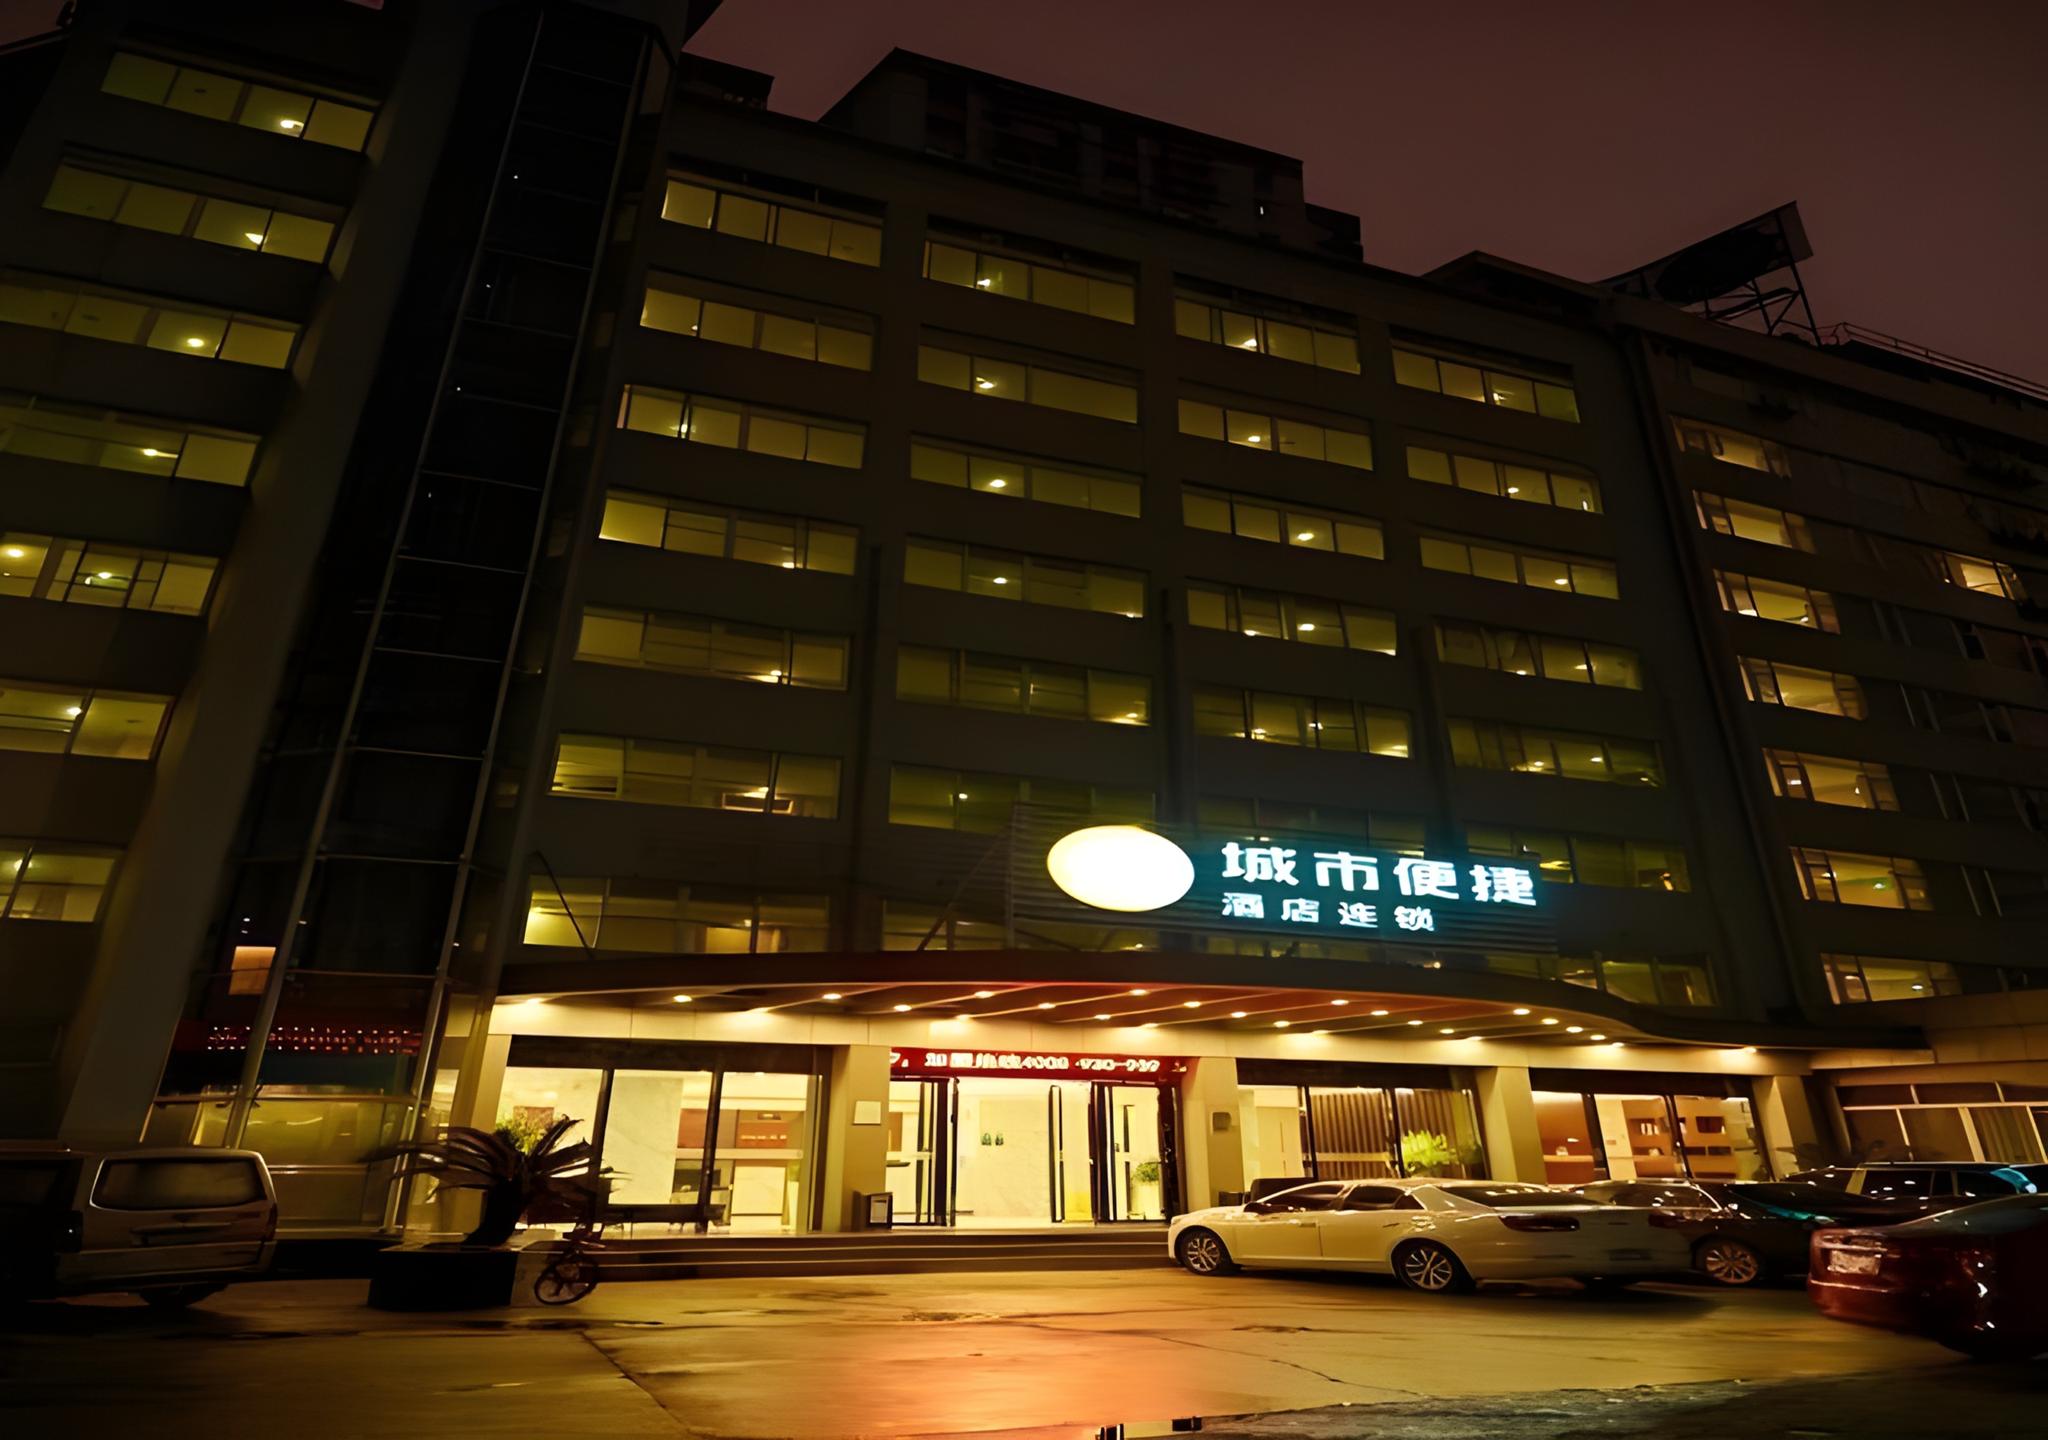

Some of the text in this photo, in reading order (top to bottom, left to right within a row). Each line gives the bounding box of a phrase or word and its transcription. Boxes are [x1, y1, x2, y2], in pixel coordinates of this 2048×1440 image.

[1221, 841, 1537, 906] 城市便捷
[1221, 891, 1435, 932] 酒店连锁
